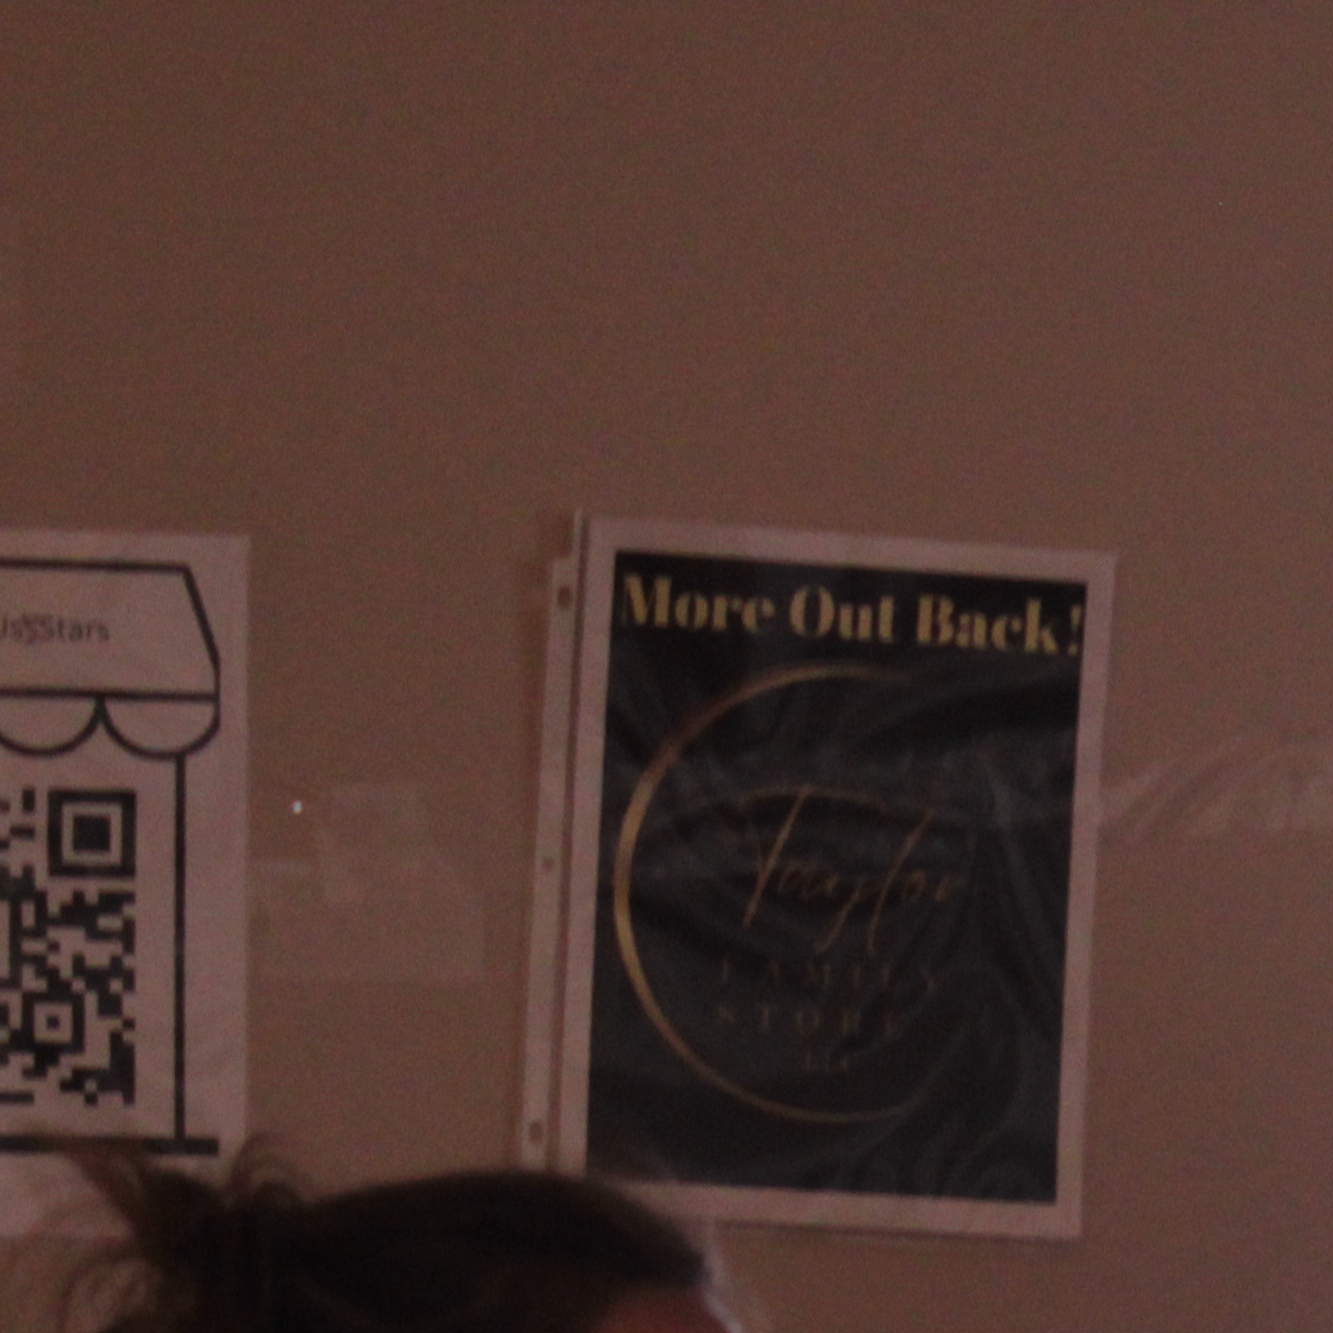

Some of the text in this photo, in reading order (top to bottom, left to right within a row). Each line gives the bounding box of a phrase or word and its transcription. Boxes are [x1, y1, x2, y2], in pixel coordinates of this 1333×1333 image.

[621, 573, 1082, 656] More Out Back!
